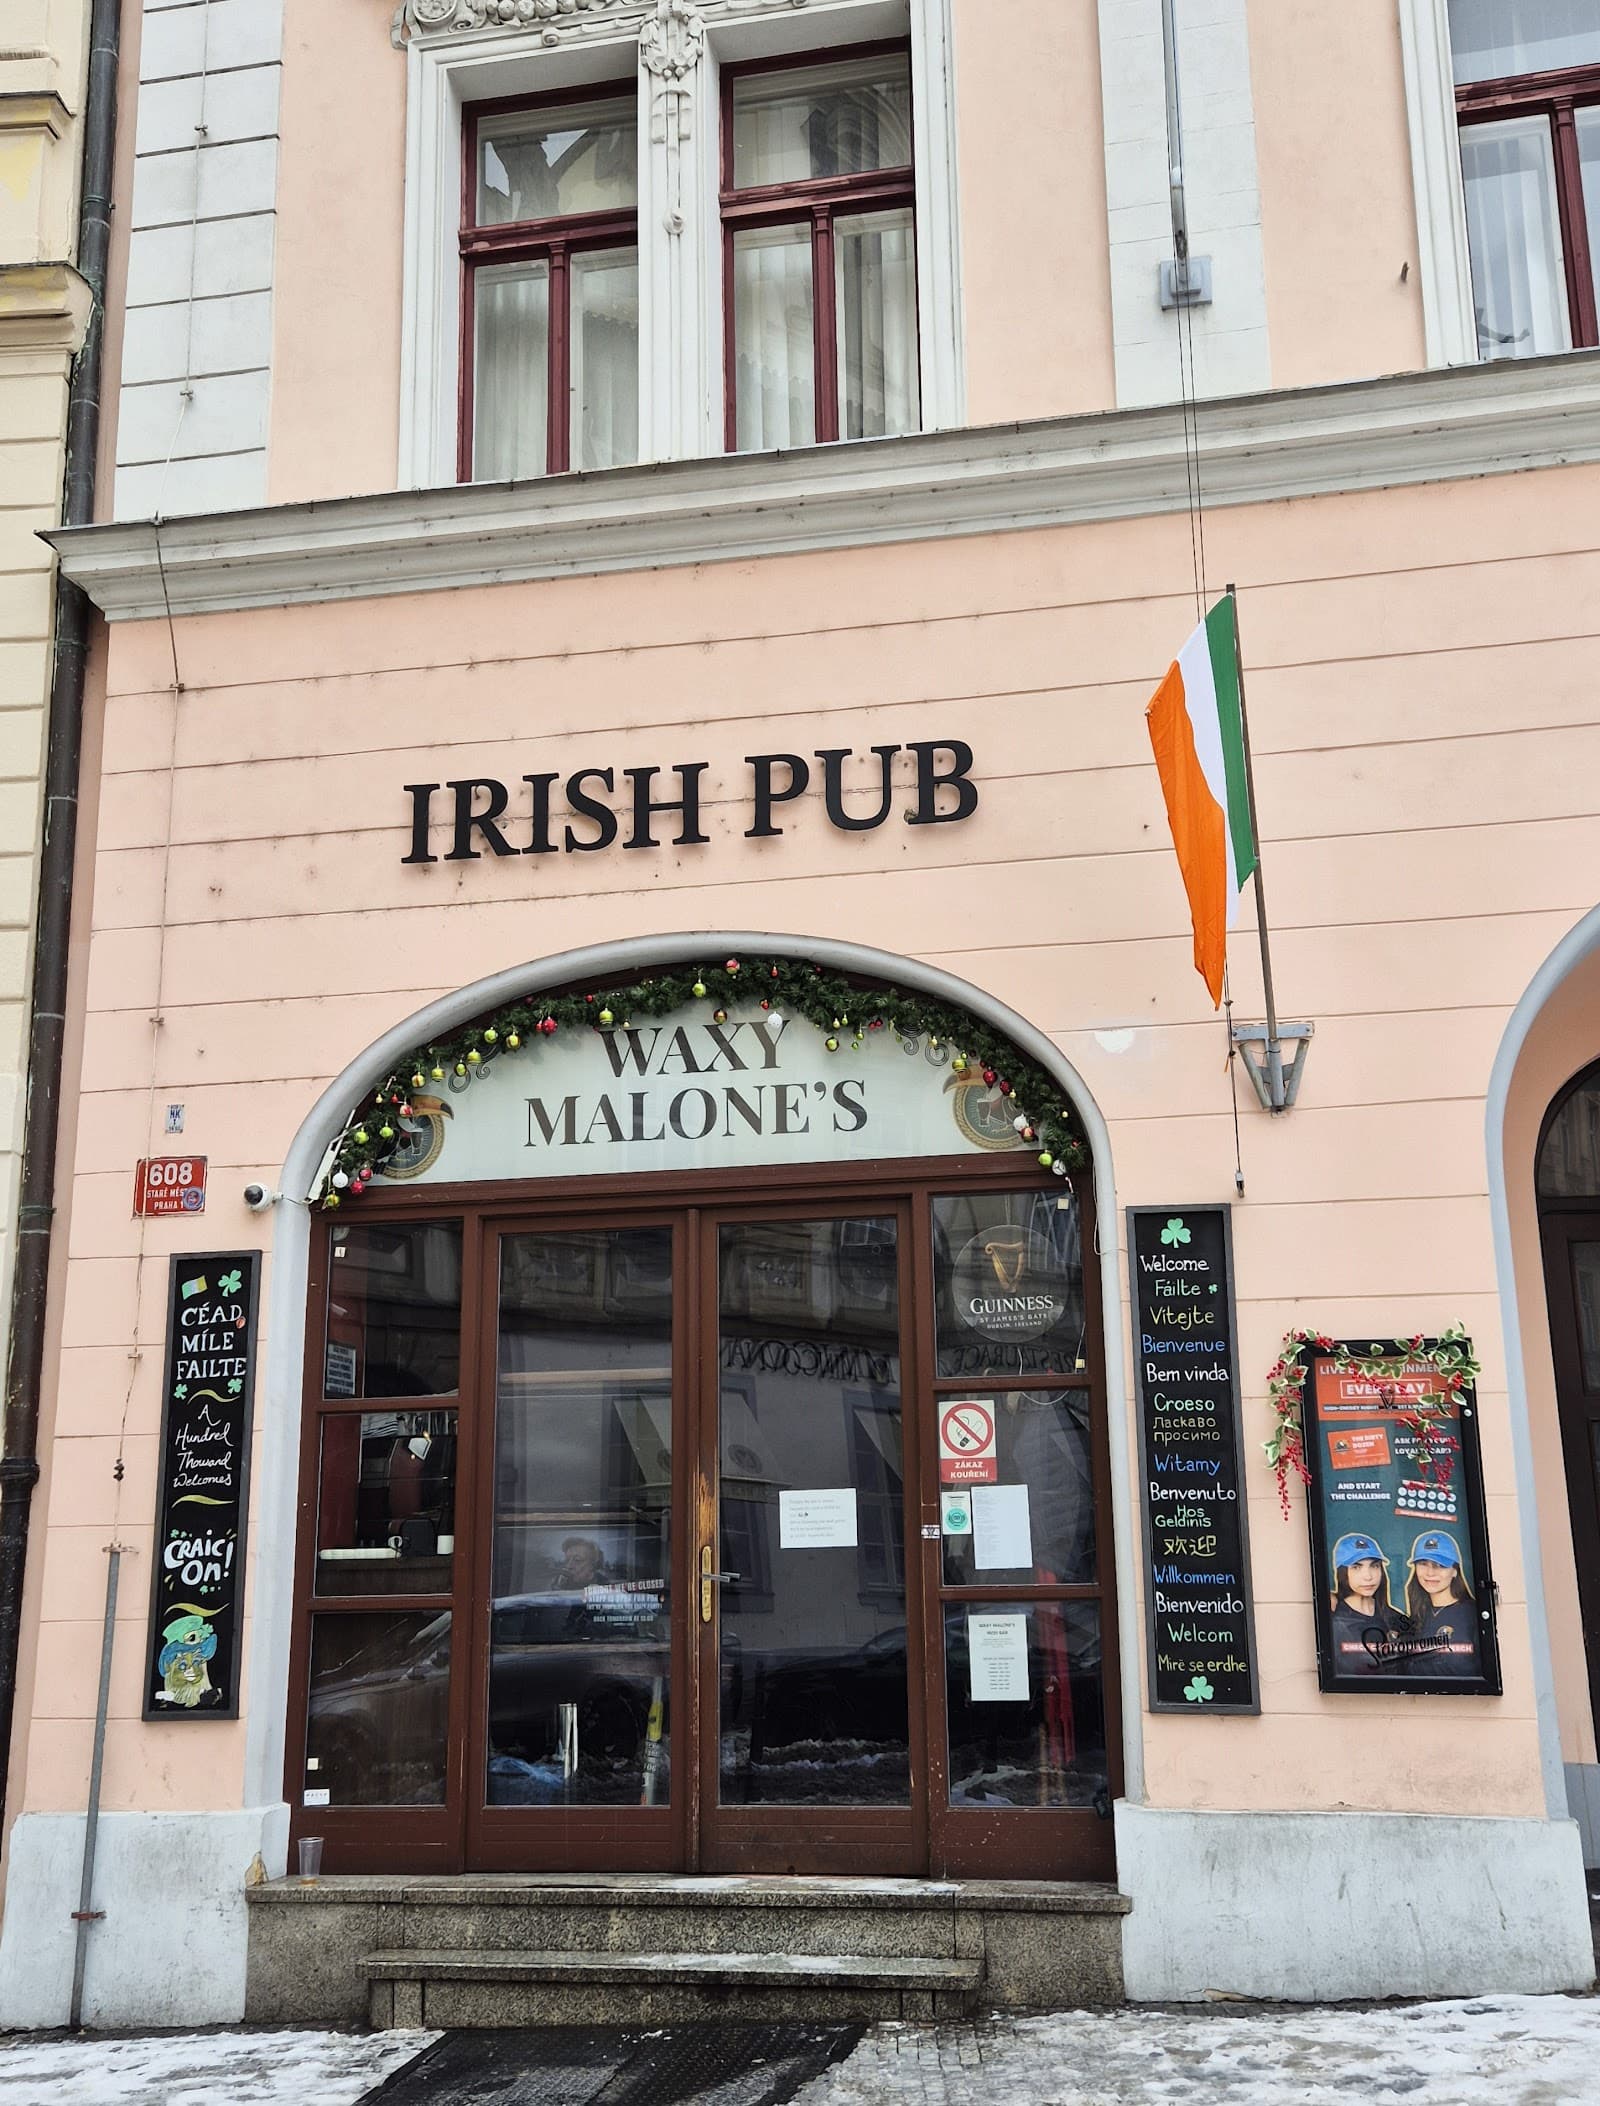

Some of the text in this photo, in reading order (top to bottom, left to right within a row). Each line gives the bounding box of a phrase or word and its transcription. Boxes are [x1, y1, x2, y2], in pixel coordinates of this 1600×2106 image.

[401, 739, 979, 864] IRISH PUB
[599, 1020, 791, 1078] WAXY
[524, 1079, 868, 1148] MALONE'S
[149, 1162, 193, 1187] 608
[154, 1200, 179, 1210] PRAHA
[1139, 1255, 1209, 1273] Welcome
[1155, 1279, 1201, 1297] Fáilte
[181, 1301, 243, 1327] CÉAD
[969, 1295, 1055, 1315] GUINNESS
[1149, 1304, 1215, 1331] Vítejte
[181, 1328, 235, 1354] MÍLE
[1142, 1334, 1226, 1354] Bienvenue
[176, 1357, 248, 1380] FAILTE
[1146, 1362, 1229, 1383] Bem vinda
[1154, 1393, 1215, 1412] Croeso
[197, 1404, 221, 1426] A
[175, 1422, 234, 1450] Hundred
[1154, 1431, 1221, 1447] просимо
[950, 1469, 989, 1479] KOUŘENÍ
[954, 1460, 984, 1469] ZÁKAZ
[1154, 1453, 1220, 1476] Witamy
[173, 1473, 232, 1488] Welcomes
[1338, 1482, 1355, 1490] AND
[1150, 1482, 1237, 1501] Benvenuto
[1163, 1534, 1217, 1557] 欢迎
[1153, 1565, 1236, 1585] Willkommen
[1155, 1591, 1245, 1614] Bienvenido
[1167, 1623, 1234, 1643] Welcom
[1361, 1627, 1450, 1665] Staropramen
[1188, 1661, 1204, 1672] se
[1206, 1654, 1248, 1672] erdhe
